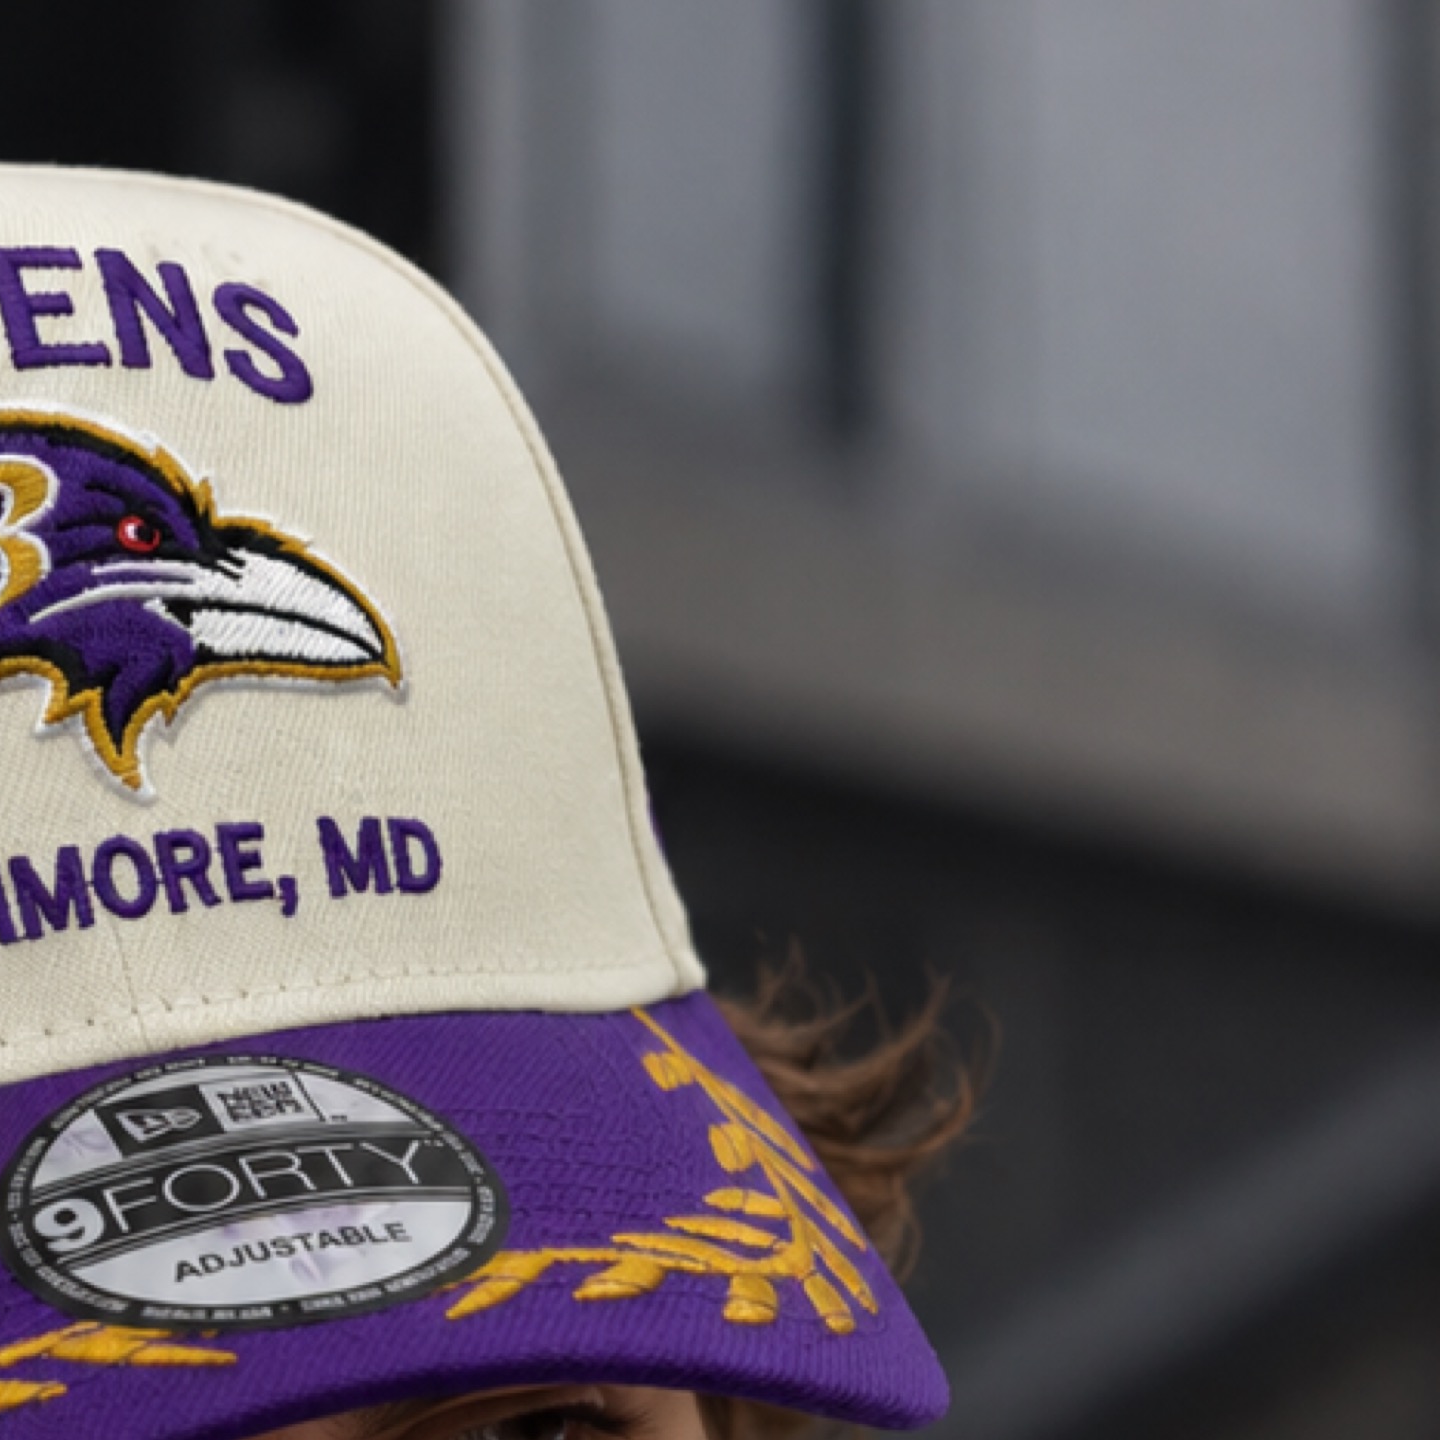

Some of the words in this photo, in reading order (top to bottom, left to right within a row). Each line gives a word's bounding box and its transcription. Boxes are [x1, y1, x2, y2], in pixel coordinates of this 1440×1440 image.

[317, 815, 443, 898] MD
[32, 1140, 422, 1253] 9FORTY
[173, 1221, 414, 1283] ADJUSTABLE
